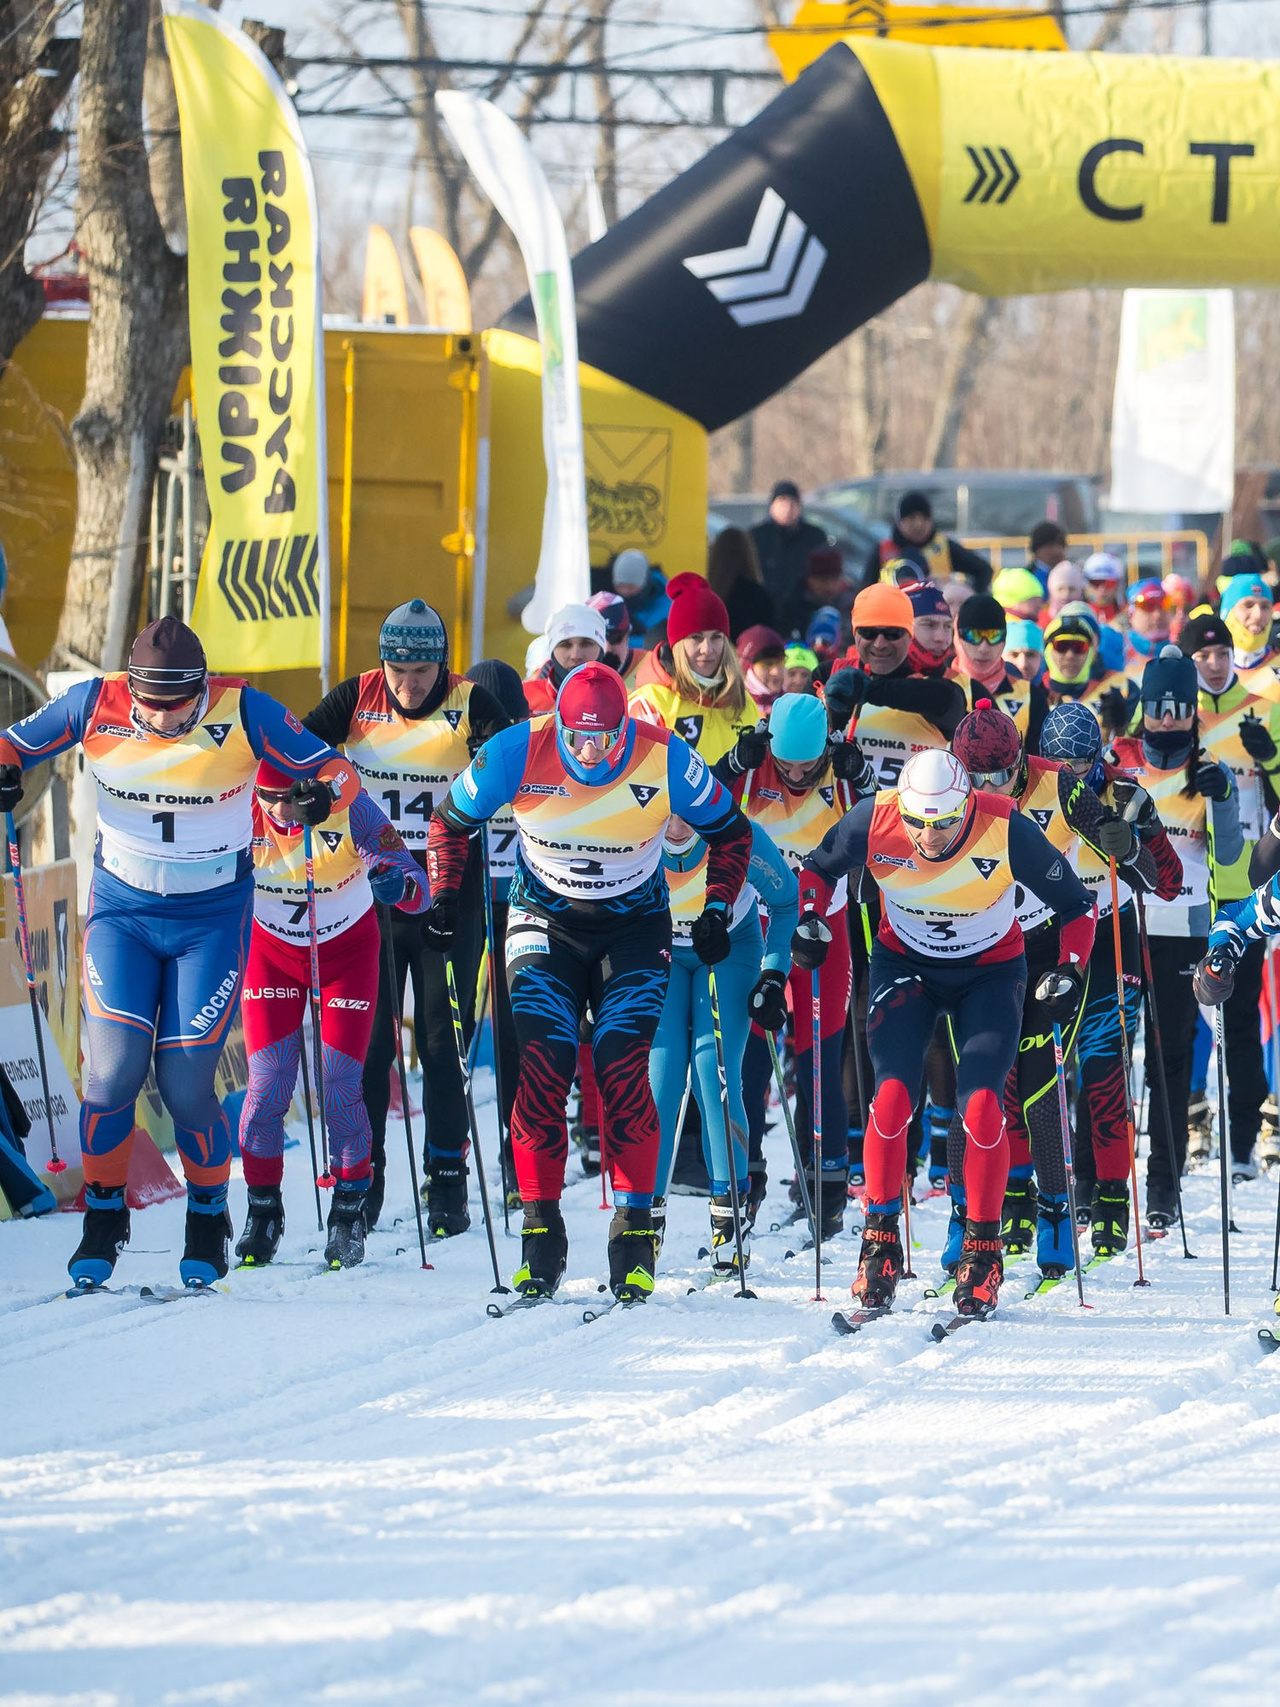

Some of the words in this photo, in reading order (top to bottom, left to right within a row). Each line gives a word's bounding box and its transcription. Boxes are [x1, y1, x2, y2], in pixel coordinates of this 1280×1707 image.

[450, 712, 457, 723] 3
[214, 725, 224, 739] 3
[682, 717, 700, 739] 3
[862, 737, 906, 750] ГОНКА
[402, 773, 449, 783] ГОНКА
[91, 770, 150, 803] ССКАЯ
[156, 794, 215, 805] ГОНКА
[638, 787, 650, 801] 3
[826, 787, 833, 801] 3
[382, 789, 434, 822] 14
[1037, 811, 1046, 824] 3
[152, 811, 175, 843] 1
[1165, 825, 1188, 837] НКА
[328, 833, 337, 847] 3
[492, 829, 517, 853] 7
[577, 843, 634, 854] ГОНКА
[428, 850, 439, 879] KV+
[981, 860, 992, 872] 3
[1080, 875, 1105, 884] НКА
[282, 900, 310, 925] 7
[925, 920, 957, 941] 3
[512, 944, 547, 956] GAZPROM
[190, 969, 239, 1032] МОСКВА
[244, 987, 300, 1001] RUSSIA
